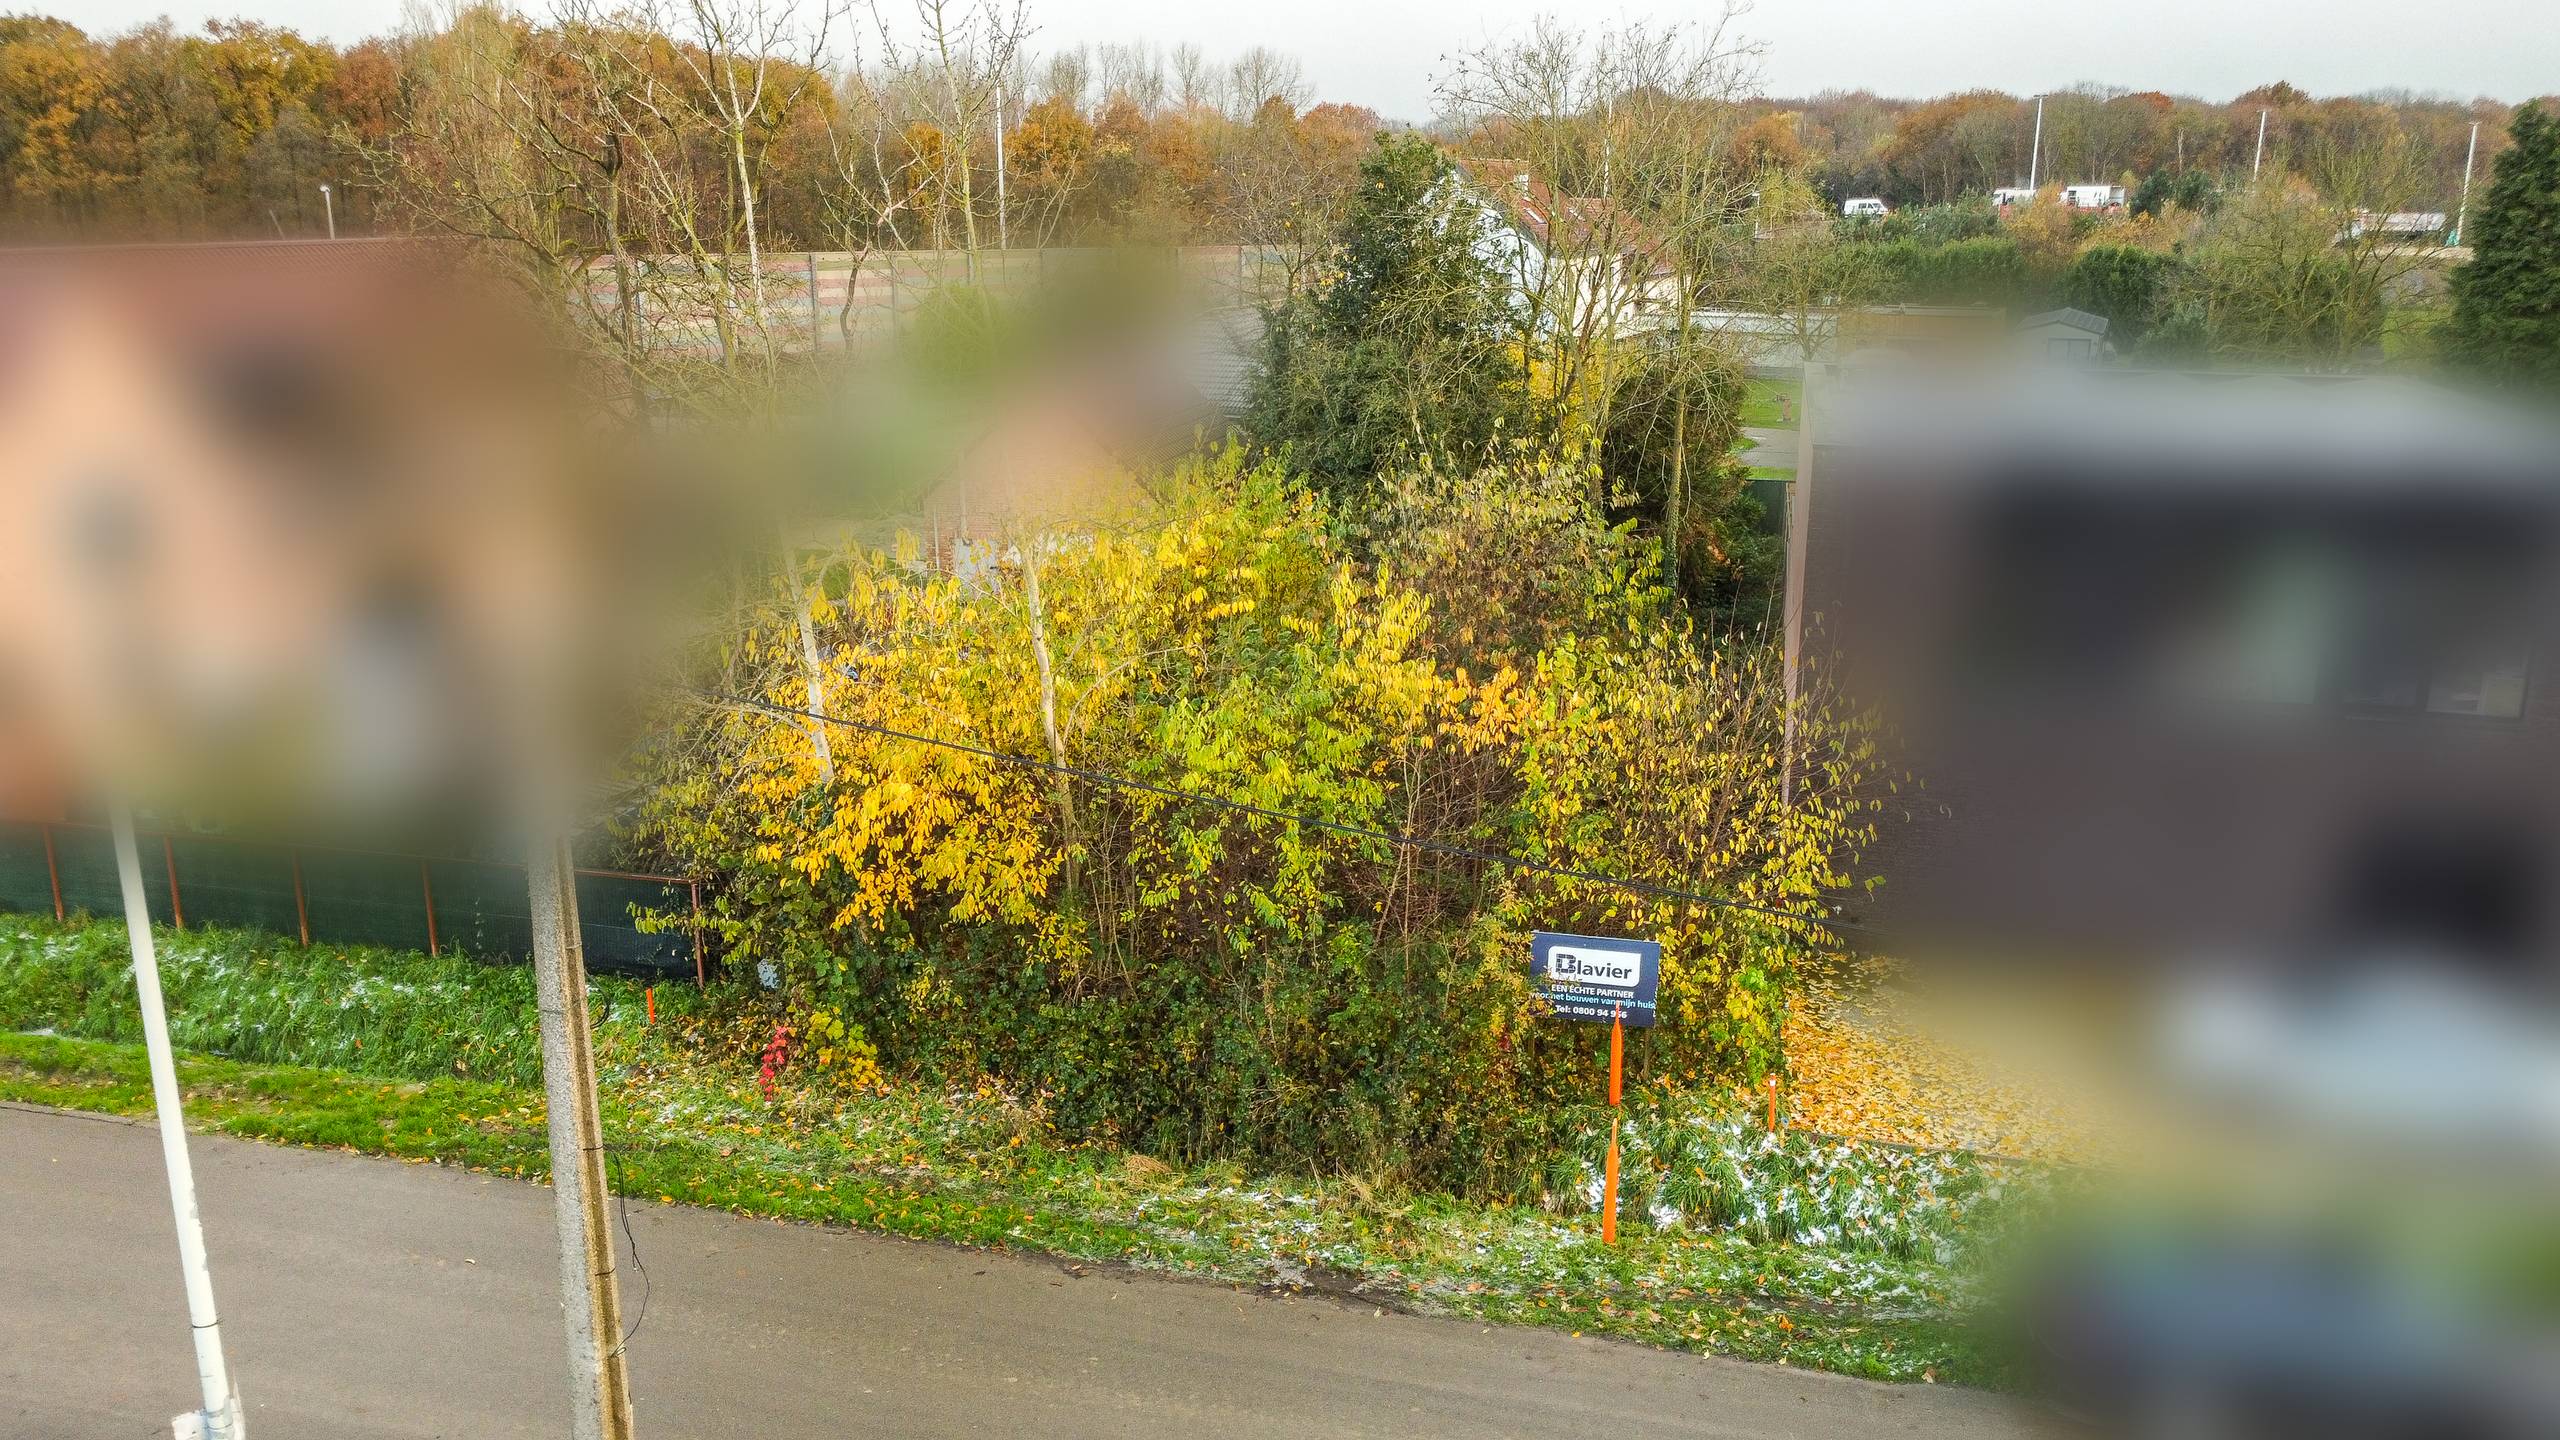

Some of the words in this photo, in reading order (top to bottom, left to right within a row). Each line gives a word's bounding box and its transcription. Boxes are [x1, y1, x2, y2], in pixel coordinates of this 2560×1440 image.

[1555, 953, 1632, 979] Blavier
[1565, 993, 1599, 1004] bouwen
[1600, 997, 1616, 1005] van
[1596, 988, 1634, 999] PARTNER
[1555, 1004, 1571, 1013] Tel:
[1572, 1006, 1595, 1015] 0800
[1596, 1009, 1609, 1017] 94
